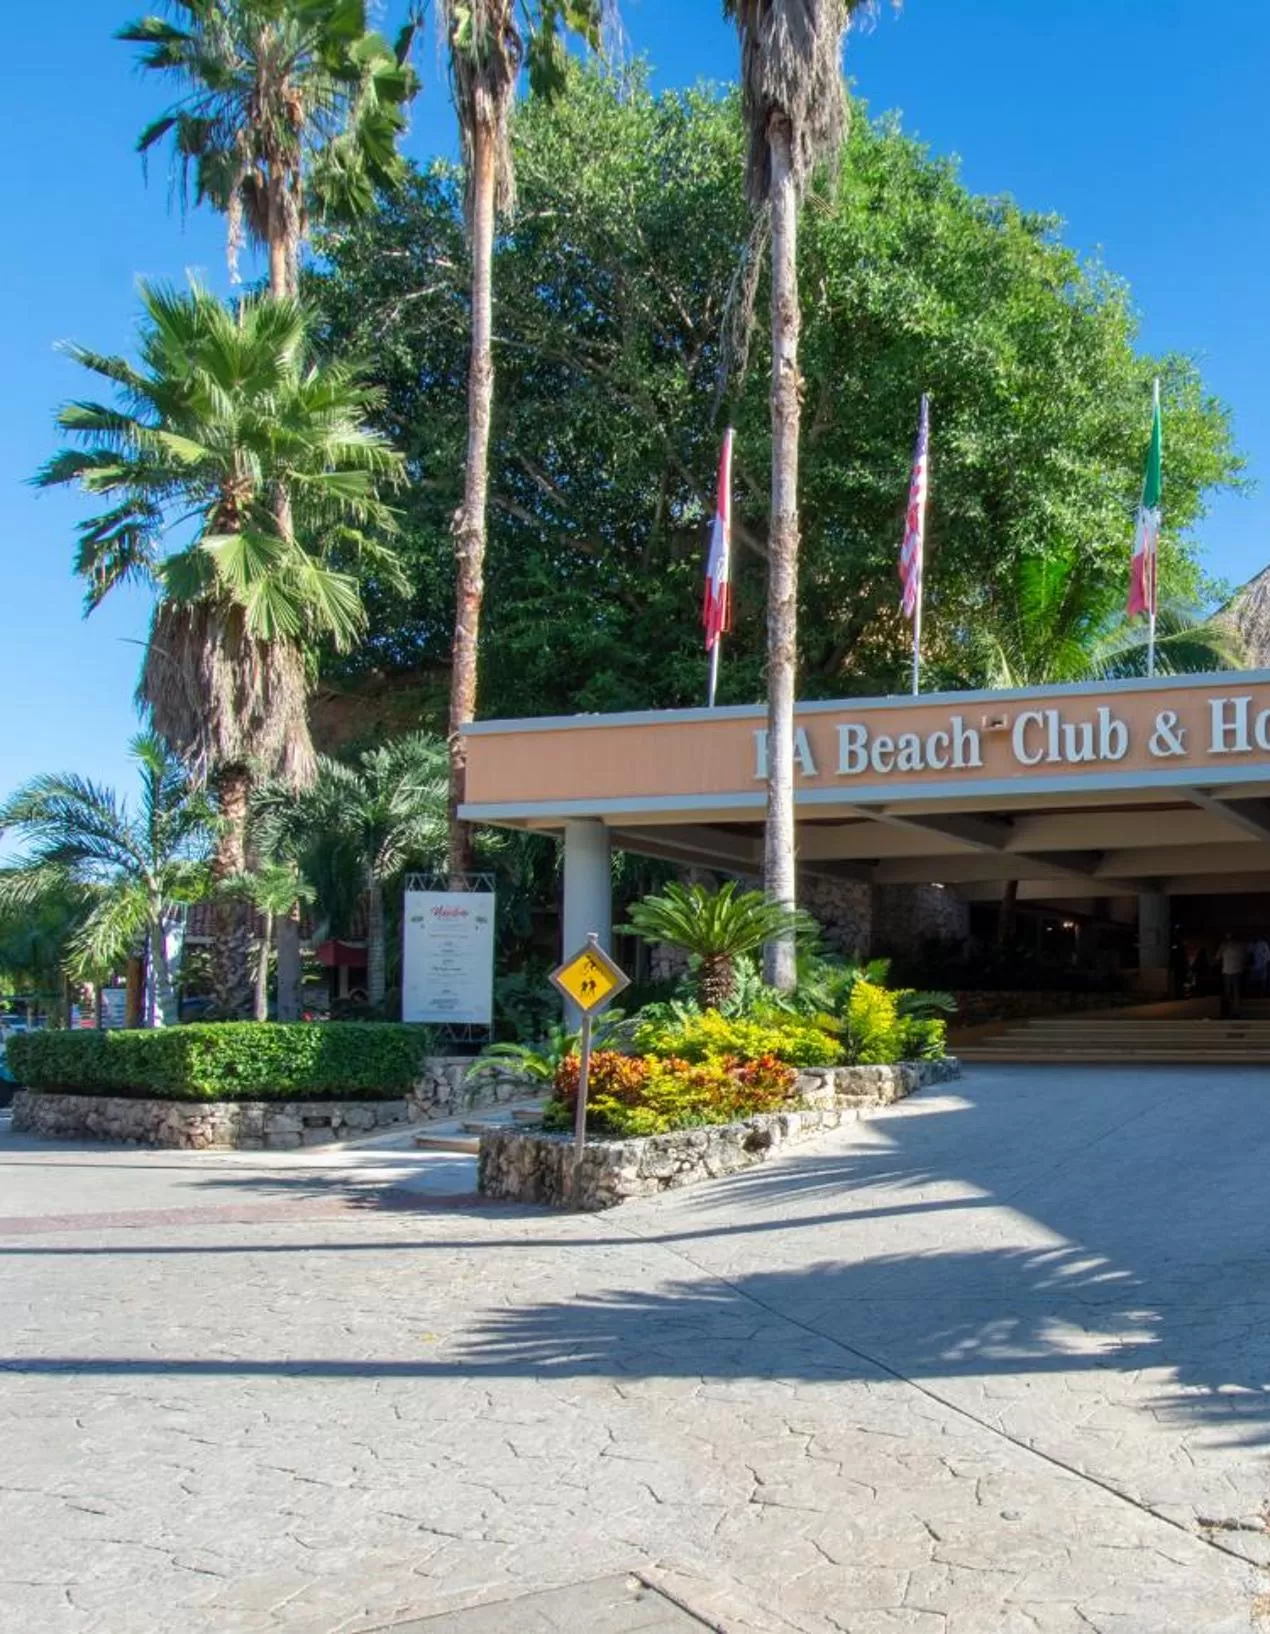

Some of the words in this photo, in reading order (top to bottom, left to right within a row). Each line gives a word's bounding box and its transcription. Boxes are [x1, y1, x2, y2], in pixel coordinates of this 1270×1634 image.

[834, 715, 983, 775] Beach
[1011, 706, 1130, 765] Club
[1147, 710, 1187, 758] &
